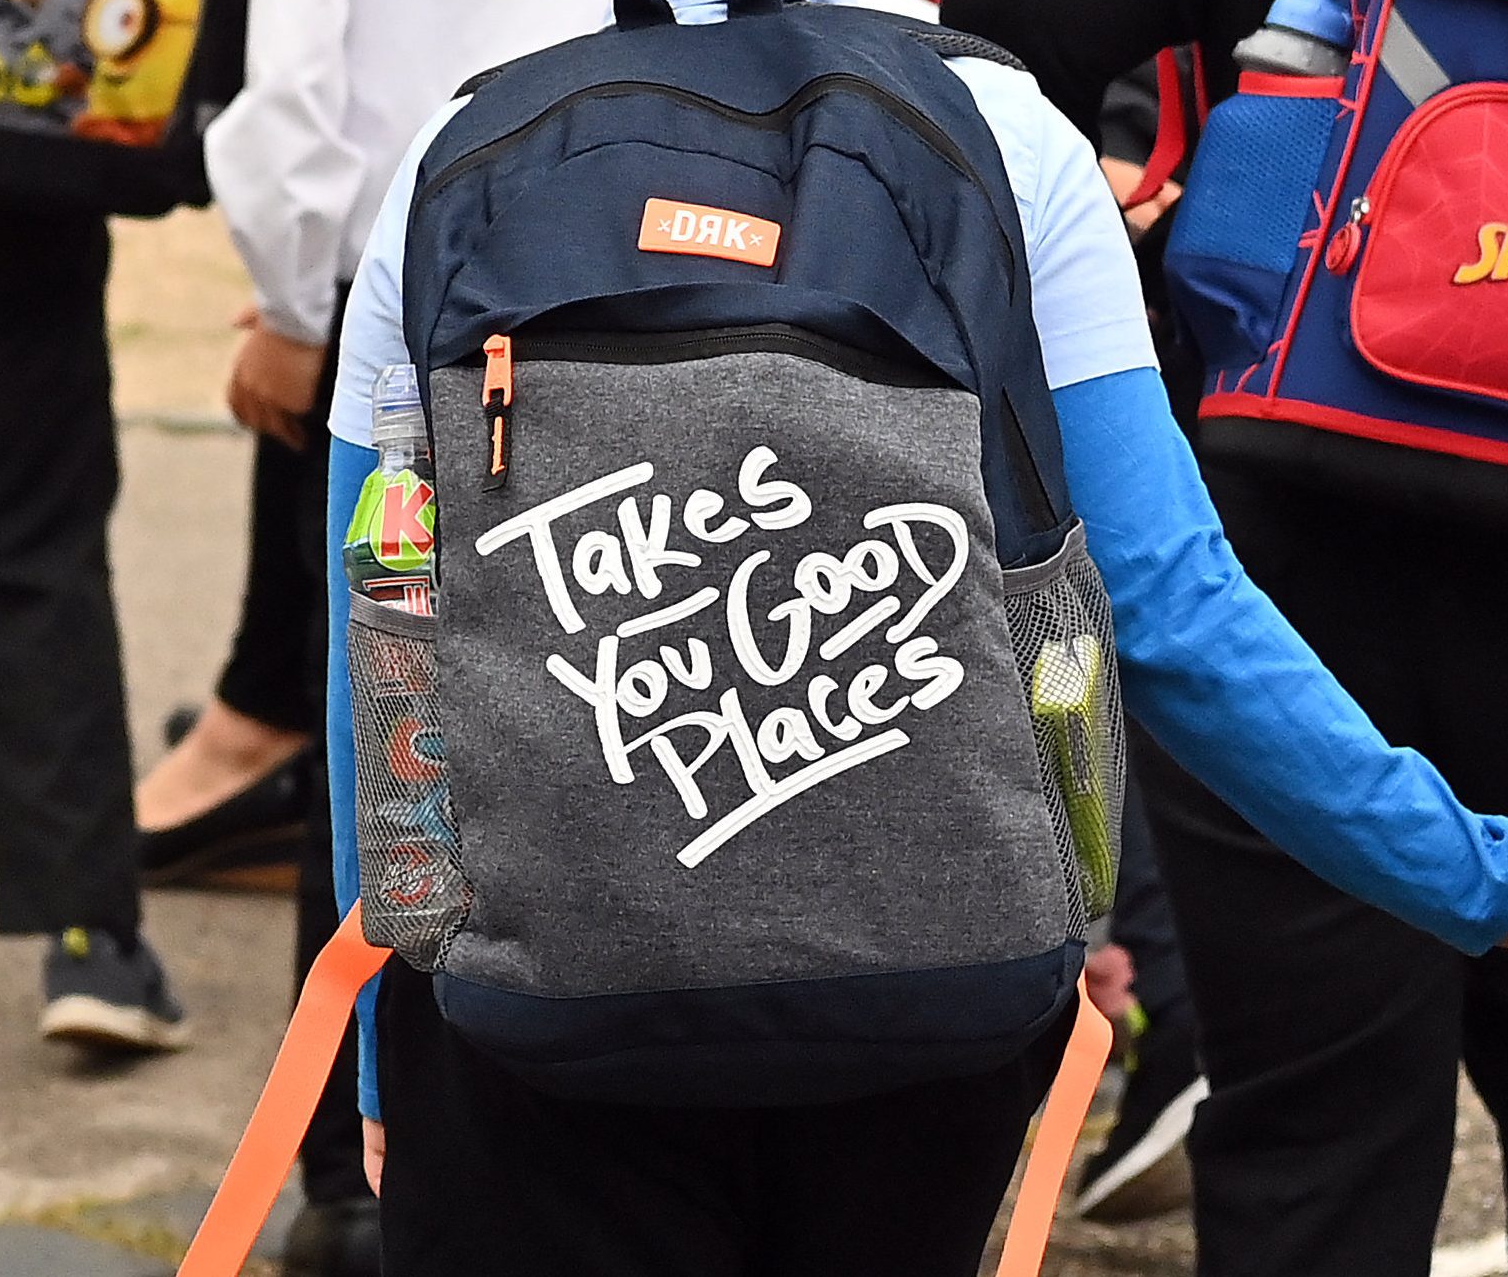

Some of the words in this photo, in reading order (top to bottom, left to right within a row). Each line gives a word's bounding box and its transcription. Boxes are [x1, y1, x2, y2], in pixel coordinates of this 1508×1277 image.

[380, 481, 435, 558] K
[546, 634, 713, 785] You
[624, 635, 965, 820] Places
